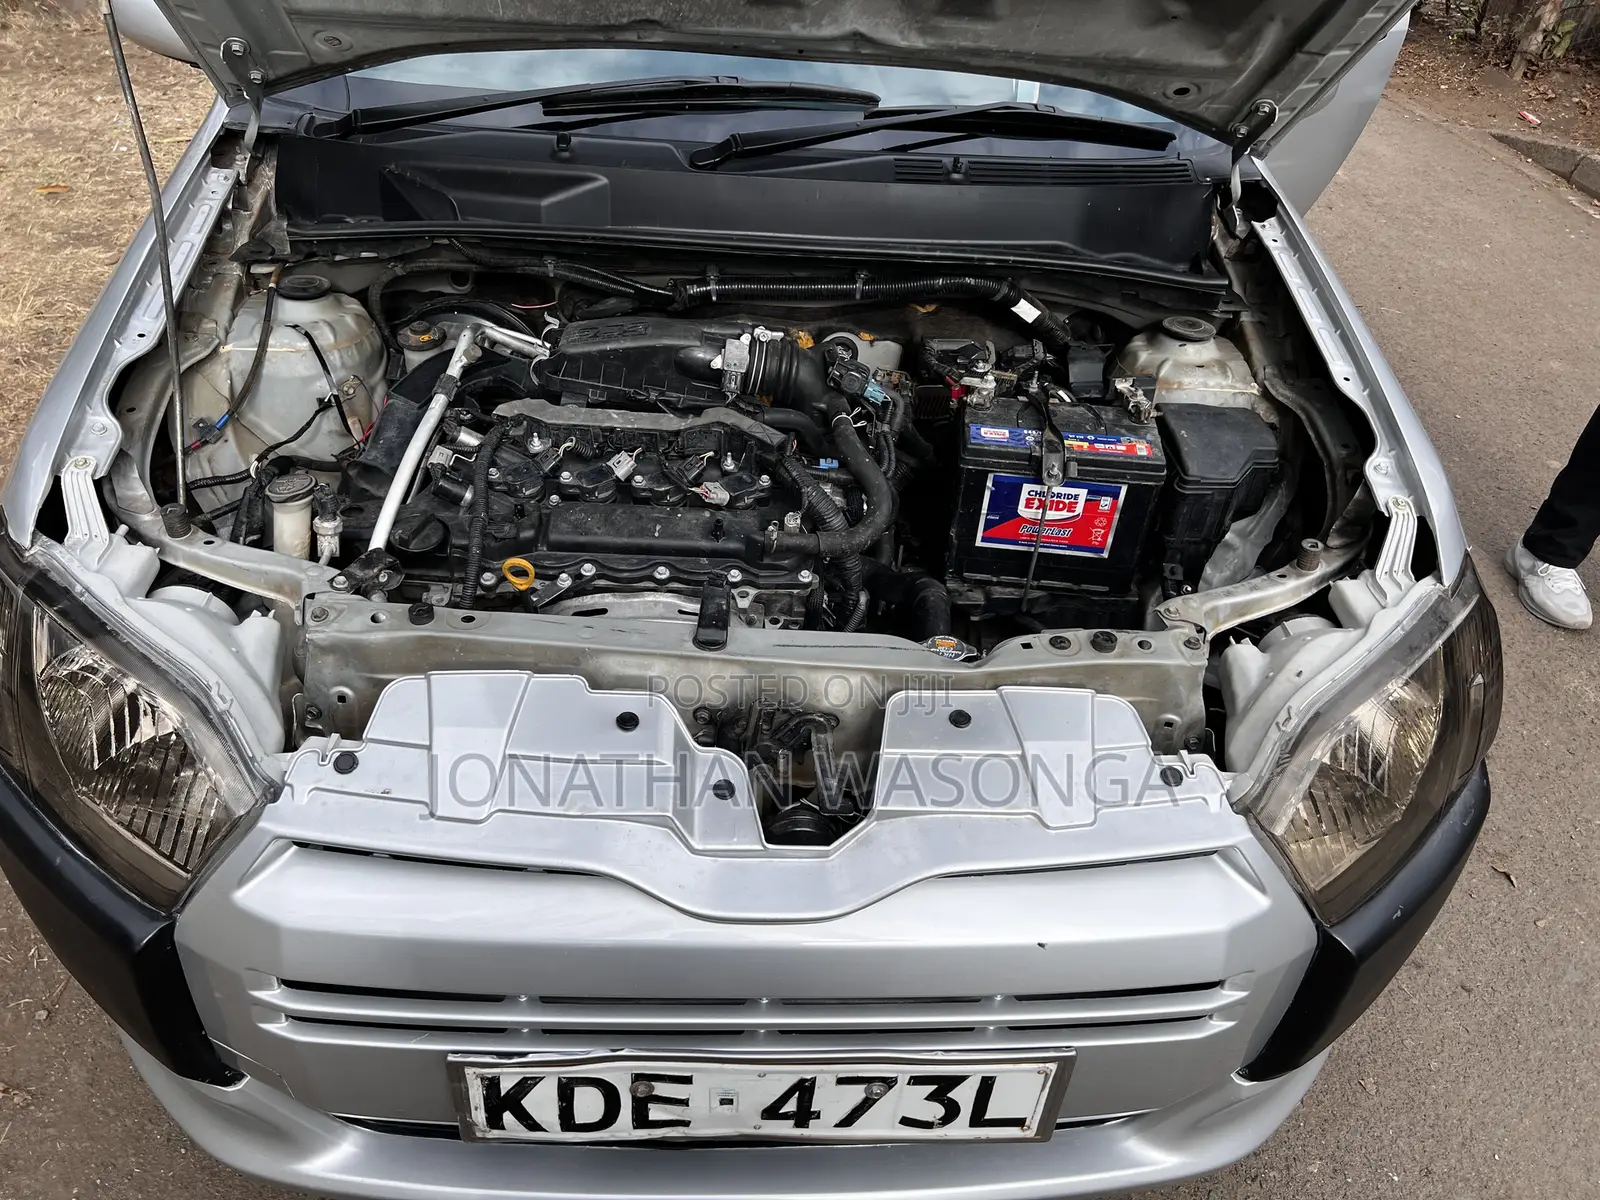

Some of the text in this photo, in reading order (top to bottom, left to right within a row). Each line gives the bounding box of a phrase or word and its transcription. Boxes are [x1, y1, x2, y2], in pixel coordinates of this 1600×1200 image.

[1028, 490, 1080, 501] CHLORIDE
[1024, 498, 1079, 513] EXIDE
[1019, 524, 1073, 537] PowerLast
[484, 1072, 1026, 1133] KDE 473L
